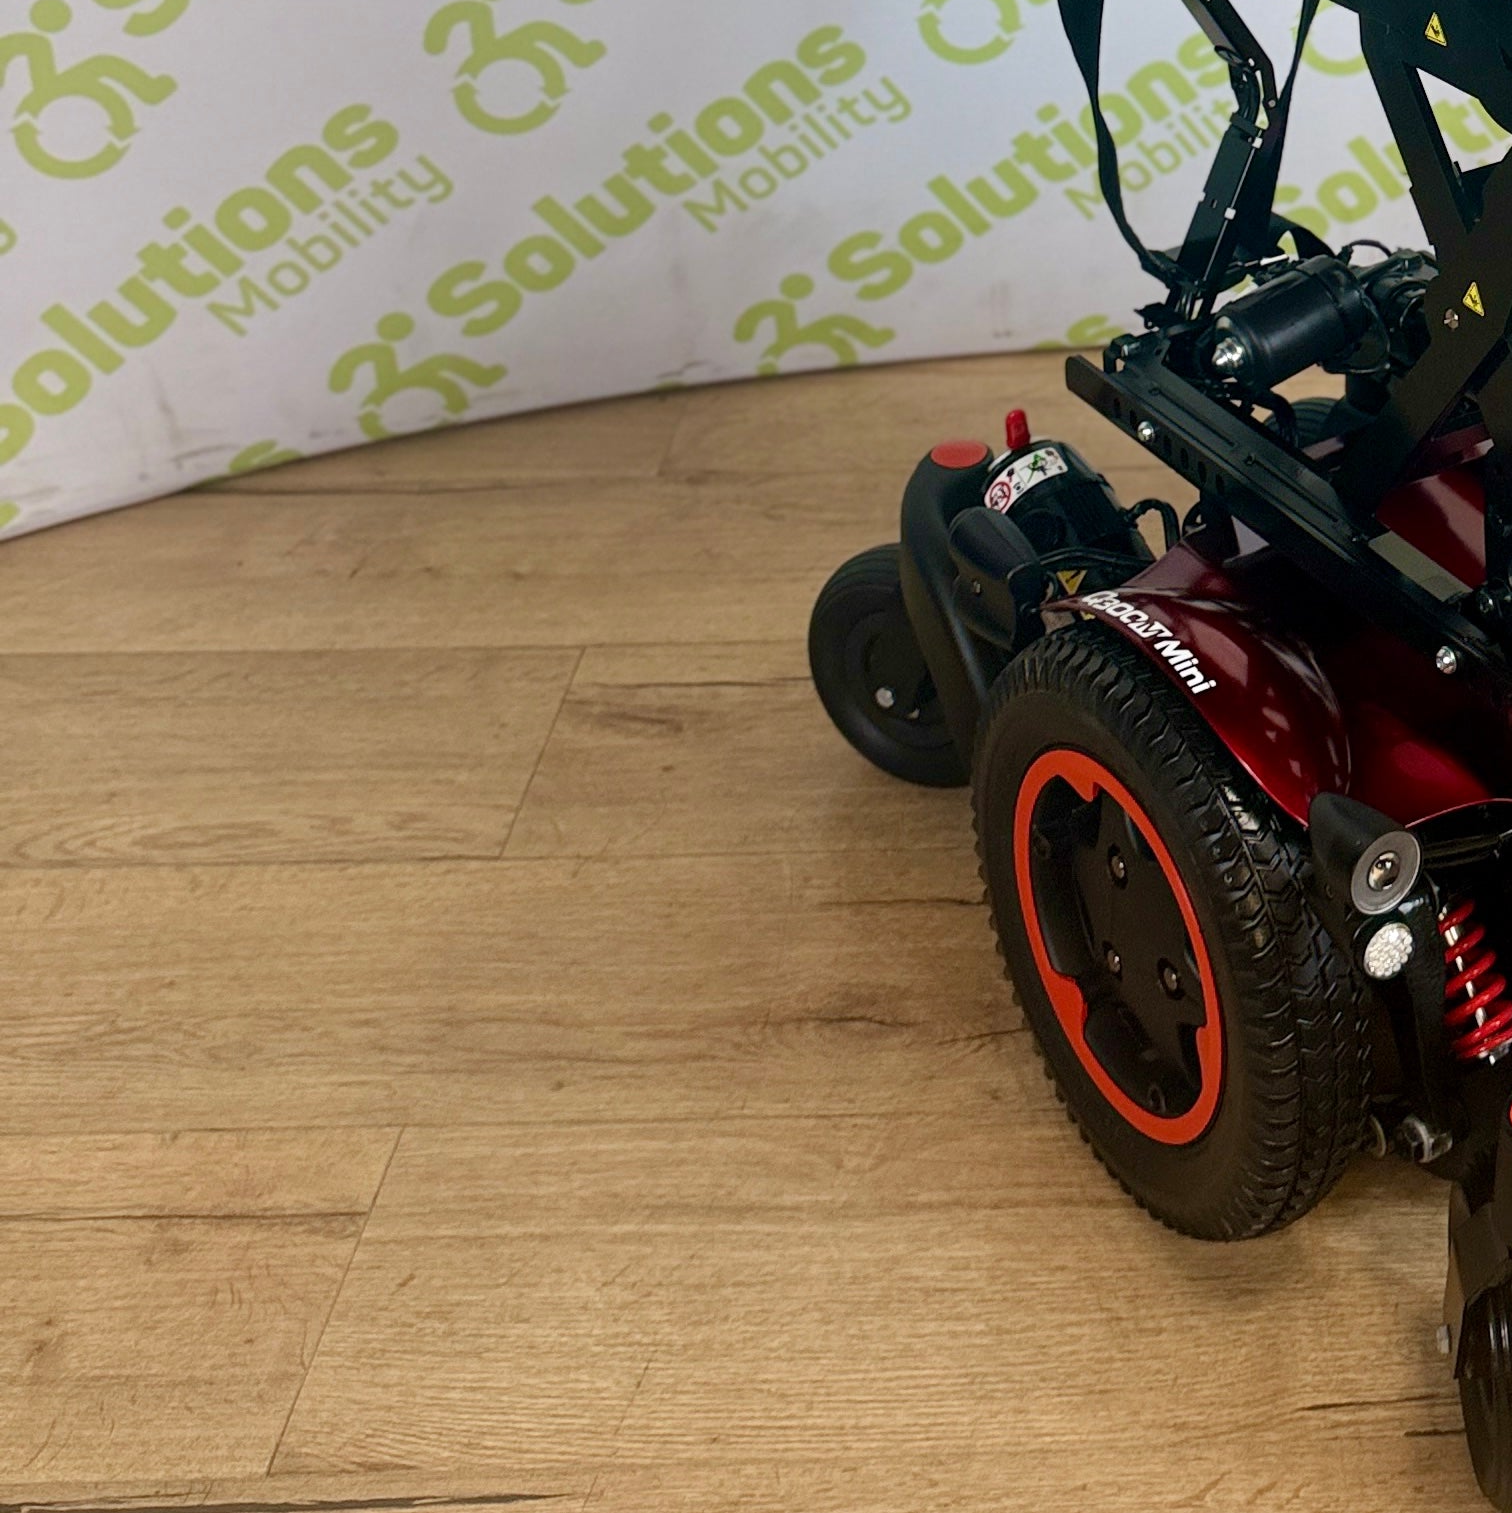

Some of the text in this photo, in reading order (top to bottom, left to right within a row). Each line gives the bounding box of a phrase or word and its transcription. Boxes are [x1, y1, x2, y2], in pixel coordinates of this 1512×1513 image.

[426, 26, 866, 337] Solutions
[682, 69, 912, 234] Mobility
[206, 154, 455, 338] Mobility
[1153, 640, 1217, 695] Mini
